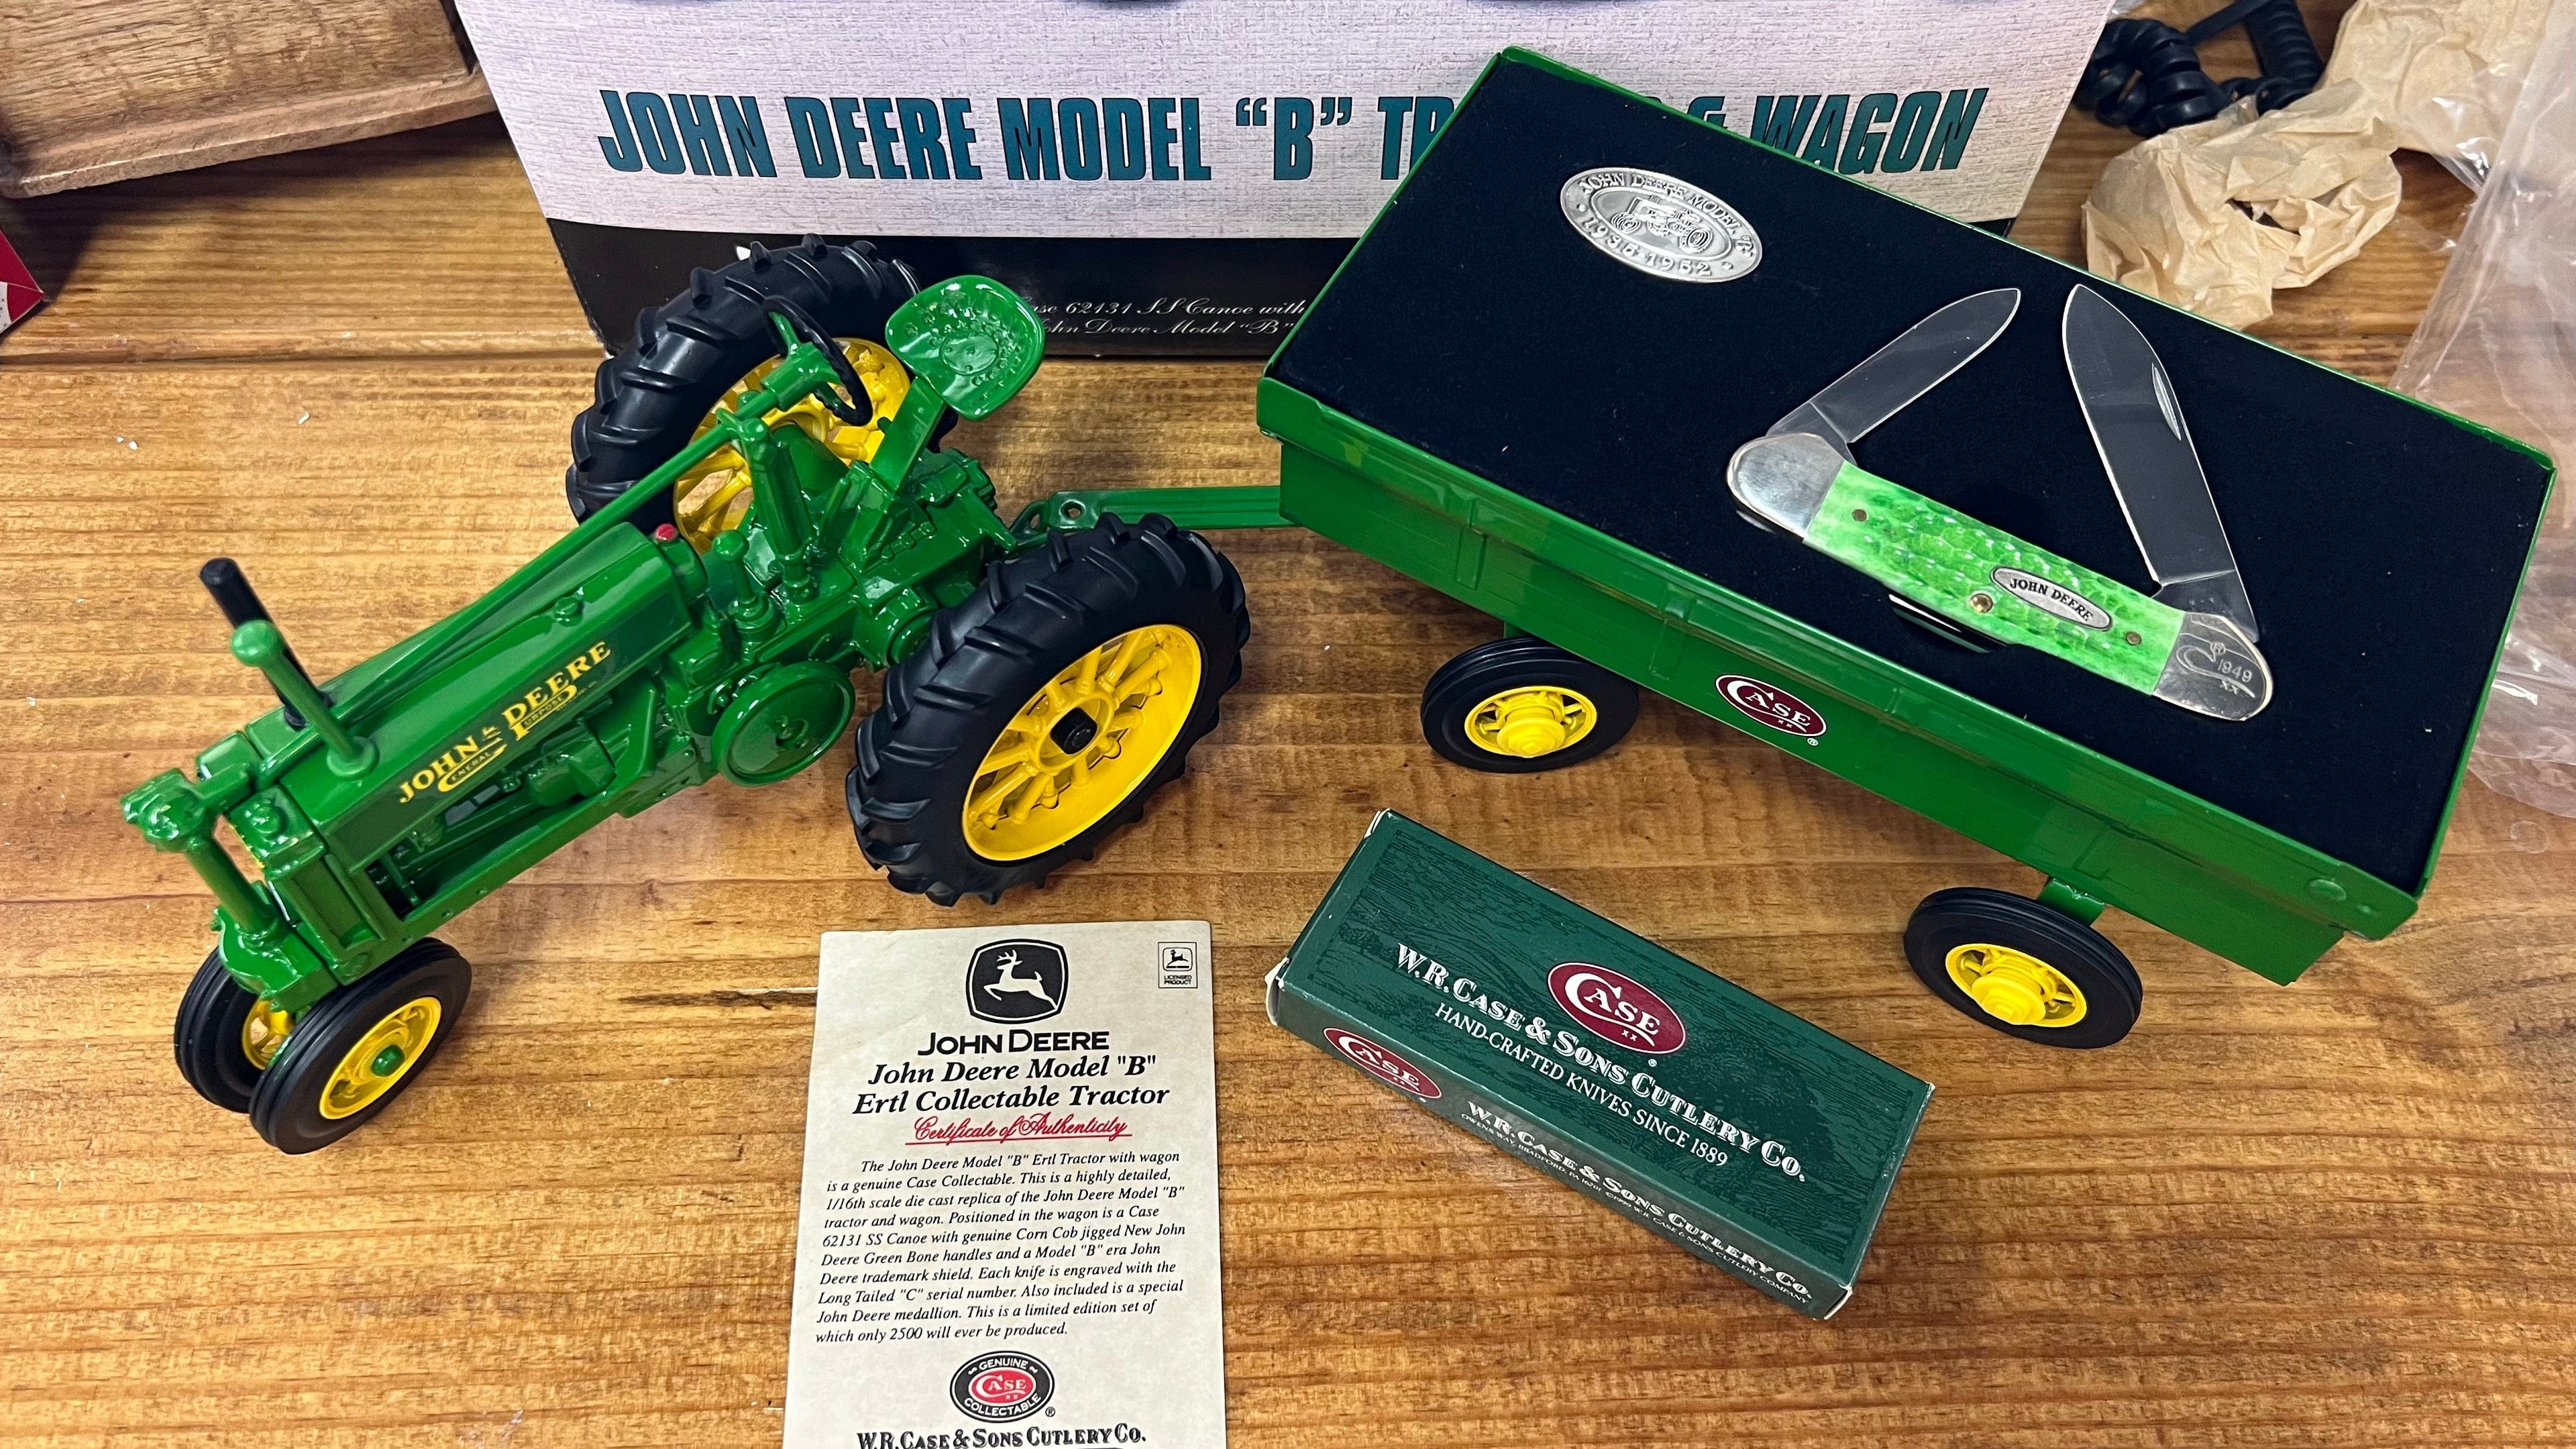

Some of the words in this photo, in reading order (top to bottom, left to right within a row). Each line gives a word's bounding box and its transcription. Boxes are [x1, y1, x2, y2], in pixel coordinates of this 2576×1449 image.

[597, 89, 778, 178] JOHN
[783, 96, 983, 180] DEERE
[996, 97, 1212, 180] MODEL
[1750, 87, 1990, 175] WAGON
[1578, 172, 1626, 195] JOHN
[1630, 173, 1687, 201] DEERE
[1688, 193, 1741, 235] MODEL
[1065, 301, 1132, 315] 62131
[1183, 297, 1254, 315] Canoe
[1258, 299, 1306, 315] with
[1085, 318, 1151, 334] Deere
[1154, 319, 1236, 334] Model
[2009, 578, 2048, 595] JOHN
[2051, 586, 2094, 623] DEERE
[2217, 659, 2253, 683] 1949
[400, 735, 480, 804] JOHN
[500, 641, 612, 727] DEERE
[917, 1032, 1003, 1056] JOHN
[1008, 1028, 1110, 1053] DEERE
[867, 1061, 934, 1085] John
[941, 1060, 1020, 1083] Deere
[1026, 1055, 1110, 1079] Model
[1118, 1054, 1157, 1077] "B"
[1434, 1002, 1565, 1080] HAND-CRAFTED
[1565, 1071, 1633, 1118] KNIVES
[1632, 1108, 1690, 1148] SINCE
[1689, 1138, 1729, 1167] 1889
[1524, 1016, 1552, 1045] &
[1552, 1030, 1629, 1085] SONS
[1631, 1072, 1761, 1154] CUTLERY
[851, 1090, 910, 1116] Ertl
[916, 1083, 1060, 1112] Collectable
[1067, 1085, 1171, 1107] Tractor
[914, 1116, 998, 1146] Certificate
[998, 1115, 1025, 1144] of
[1018, 1111, 1128, 1142] Authenticity
[861, 1161, 884, 1173] The
[888, 1159, 918, 1171] John
[921, 1159, 959, 1170] Deere
[962, 1155, 1003, 1169] Model
[1008, 1155, 1029, 1167] "B"
[1032, 1153, 1057, 1165] Ertl
[1060, 1153, 1106, 1165] Tractor
[1109, 1151, 1135, 1163] with
[1140, 1153, 1179, 1165] wagon
[852, 1178, 902, 1193] genuine
[906, 1176, 937, 1188] Case
[942, 1173, 1015, 1187] Collectable.
[1020, 1172, 1046, 1184] This
[1075, 1169, 1115, 1185] highly
[1118, 1168, 1171, 1181] detailed,
[826, 1197, 865, 1210] 1/16th
[869, 1195, 902, 1208] scale
[905, 1195, 925, 1207] die
[928, 1195, 954, 1206] cast
[957, 1192, 1001, 1208] replica
[1043, 1189, 1073, 1202] John
[1077, 1189, 1114, 1201] Deere
[1118, 1186, 1159, 1199] Model
[1163, 1186, 1185, 1198] "B"
[1461, 1113, 1495, 1134] OWENS
[1686, 1235, 1714, 1253] SONS
[1715, 1250, 1759, 1277] CUTLERY
[1760, 1274, 1809, 1304] COMPANY
[824, 1218, 868, 1228] tractor
[871, 1214, 896, 1226] and
[900, 1216, 943, 1228] wagon.
[949, 1209, 1016, 1224] Positioned
[1057, 1210, 1098, 1222] wagon
[1129, 1205, 1159, 1218] Case
[1578, 1165, 1601, 1183] &
[1602, 1177, 1665, 1217] SONS
[1667, 1212, 1776, 1275] CUTLERY
[822, 1234, 861, 1247] 62131
[865, 1233, 883, 1246] SS
[887, 1232, 927, 1244] Canoe
[931, 1230, 958, 1243] with
[961, 1229, 1012, 1245] genuine
[1016, 1228, 1048, 1240] Corn
[1053, 1226, 1078, 1239] Cob
[1079, 1224, 1122, 1241] jigged
[1124, 1224, 1152, 1236] New
[1155, 1223, 1185, 1236] John
[820, 1254, 860, 1266] Deere
[864, 1252, 902, 1265] Green
[906, 1251, 939, 1263] Bone
[943, 1248, 992, 1261] handles
[996, 1246, 1021, 1260] and
[1035, 1244, 1076, 1258] Model
[1081, 1244, 1103, 1256] "B"
[1130, 1242, 1161, 1255] John
[820, 1273, 859, 1285] Deere
[862, 1269, 928, 1283] trademark
[932, 1267, 973, 1281] shield.
[978, 1266, 1010, 1279] Each
[1014, 1265, 1045, 1281] knife
[1063, 1261, 1123, 1279] engraved
[1126, 1261, 1152, 1274] with
[818, 1292, 851, 1306] Long
[855, 1289, 896, 1303] Tailed
[900, 1288, 924, 1301] "C"
[926, 1287, 964, 1300] serial
[967, 1285, 1016, 1299] number.
[1020, 1284, 1050, 1297] Also
[1053, 1281, 1109, 1296] included
[1138, 1279, 1183, 1296] special
[816, 1310, 847, 1323] John
[852, 1309, 891, 1322] Deere
[894, 1307, 961, 1320] medallion.
[967, 1305, 994, 1318] This
[1025, 1301, 1070, 1316] limited
[1073, 1301, 1116, 1314] edition
[1121, 1302, 1139, 1312] set
[816, 1329, 853, 1342] which
[857, 1328, 886, 1344] only
[890, 1327, 923, 1340] 2500
[926, 1326, 951, 1339] will
[955, 1328, 983, 1338] ever
[1004, 1322, 1067, 1340] produced.
[979, 1357, 1028, 1371] GENUINE
[964, 1392, 1042, 1417] COLLECTABLE
[953, 1428, 971, 1449] &
[972, 1428, 1023, 1448] SONS
[1026, 1426, 1113, 1446] CUTLERY
